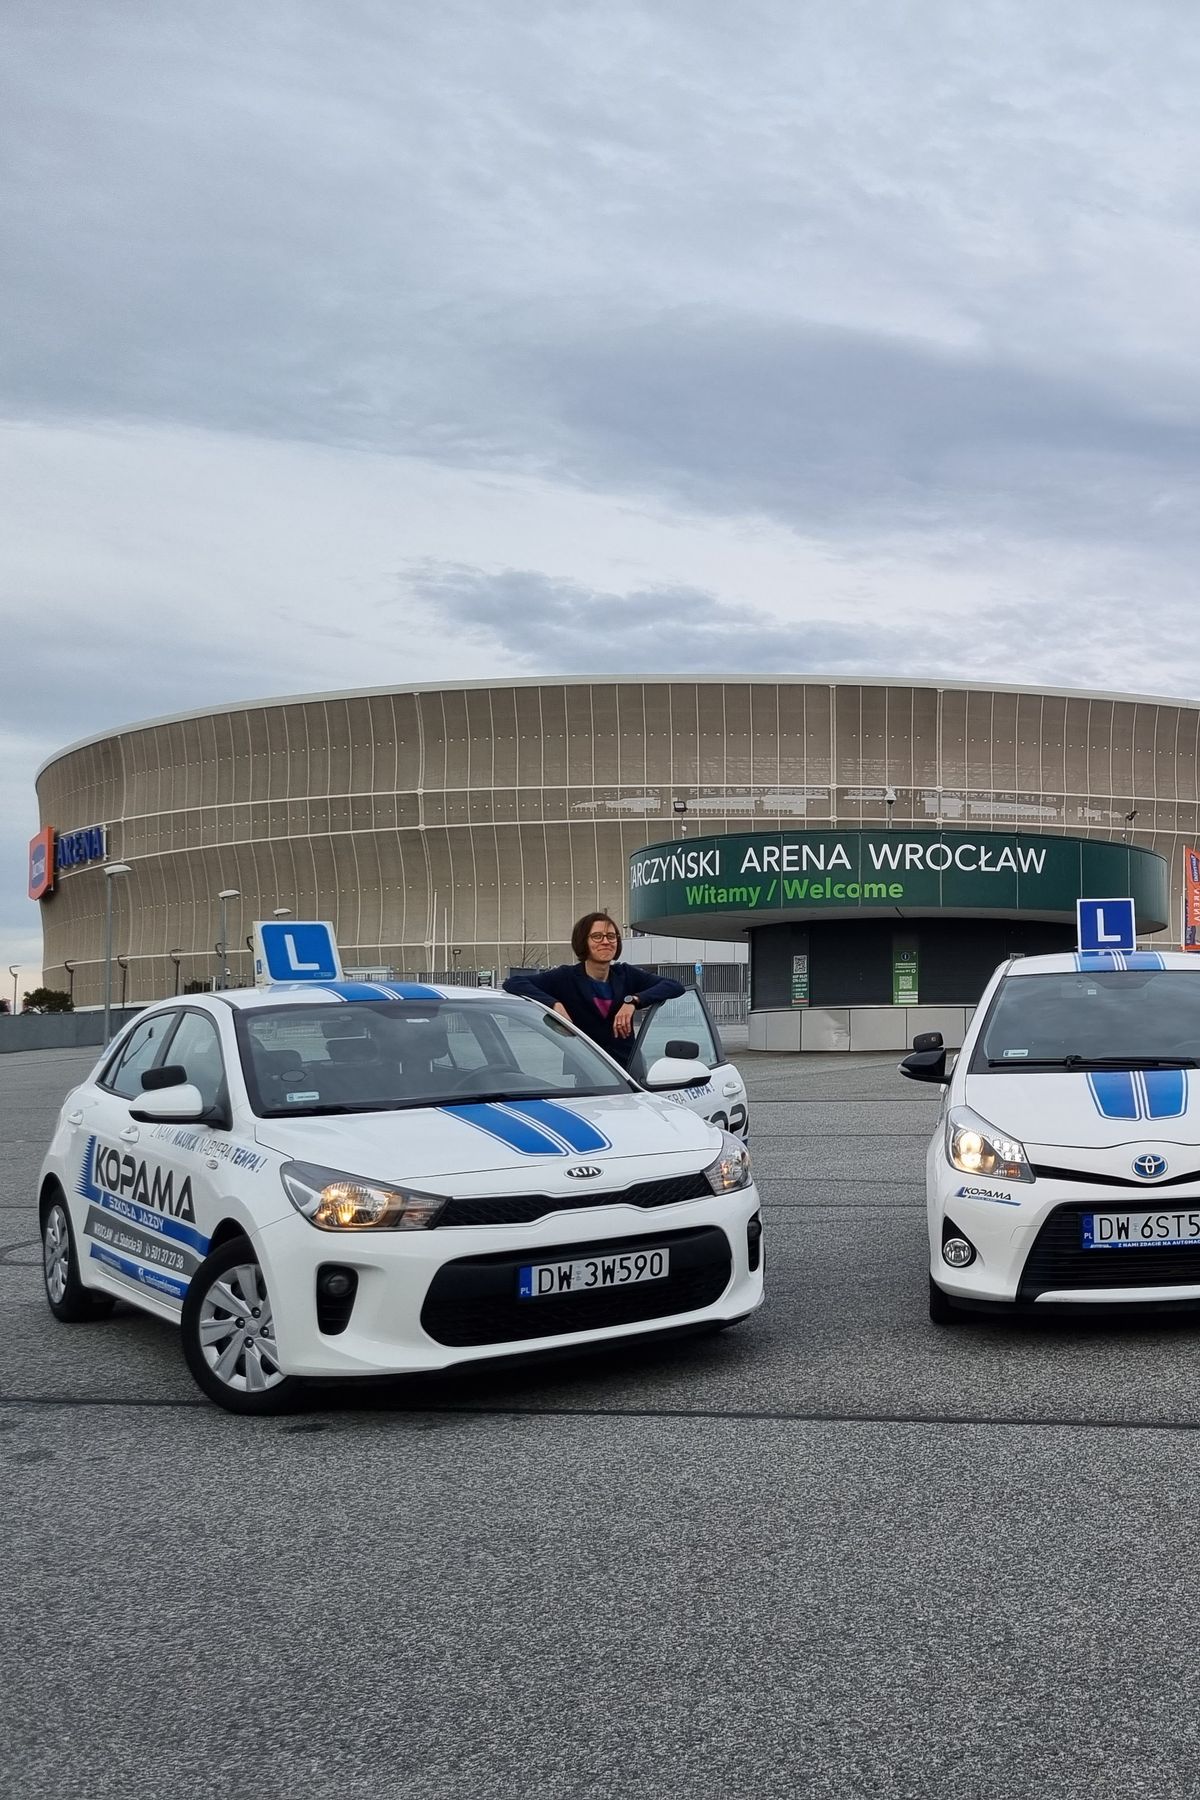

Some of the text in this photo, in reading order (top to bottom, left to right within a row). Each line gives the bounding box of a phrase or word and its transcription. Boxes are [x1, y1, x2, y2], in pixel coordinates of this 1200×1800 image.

[740, 844, 852, 873] ARENA
[868, 843, 1047, 874] WROCŁAW
[685, 877, 904, 907] Witamy / Welcome
[1097, 908, 1121, 942] L
[284, 934, 320, 970] L
[172, 1130, 199, 1153] NAUKA
[198, 1138, 233, 1160] NABIERA
[230, 1147, 261, 1172] TEMPA
[95, 1144, 197, 1224] KOPAMA
[572, 1167, 599, 1177] KIA
[964, 1187, 1012, 1200] KOPAMA
[109, 1196, 164, 1231] SZKOŁA JAZDY
[1099, 1217, 1129, 1240] DW
[151, 1245, 161, 1260] 501
[520, 1252, 663, 1295] PL DW 3W590
